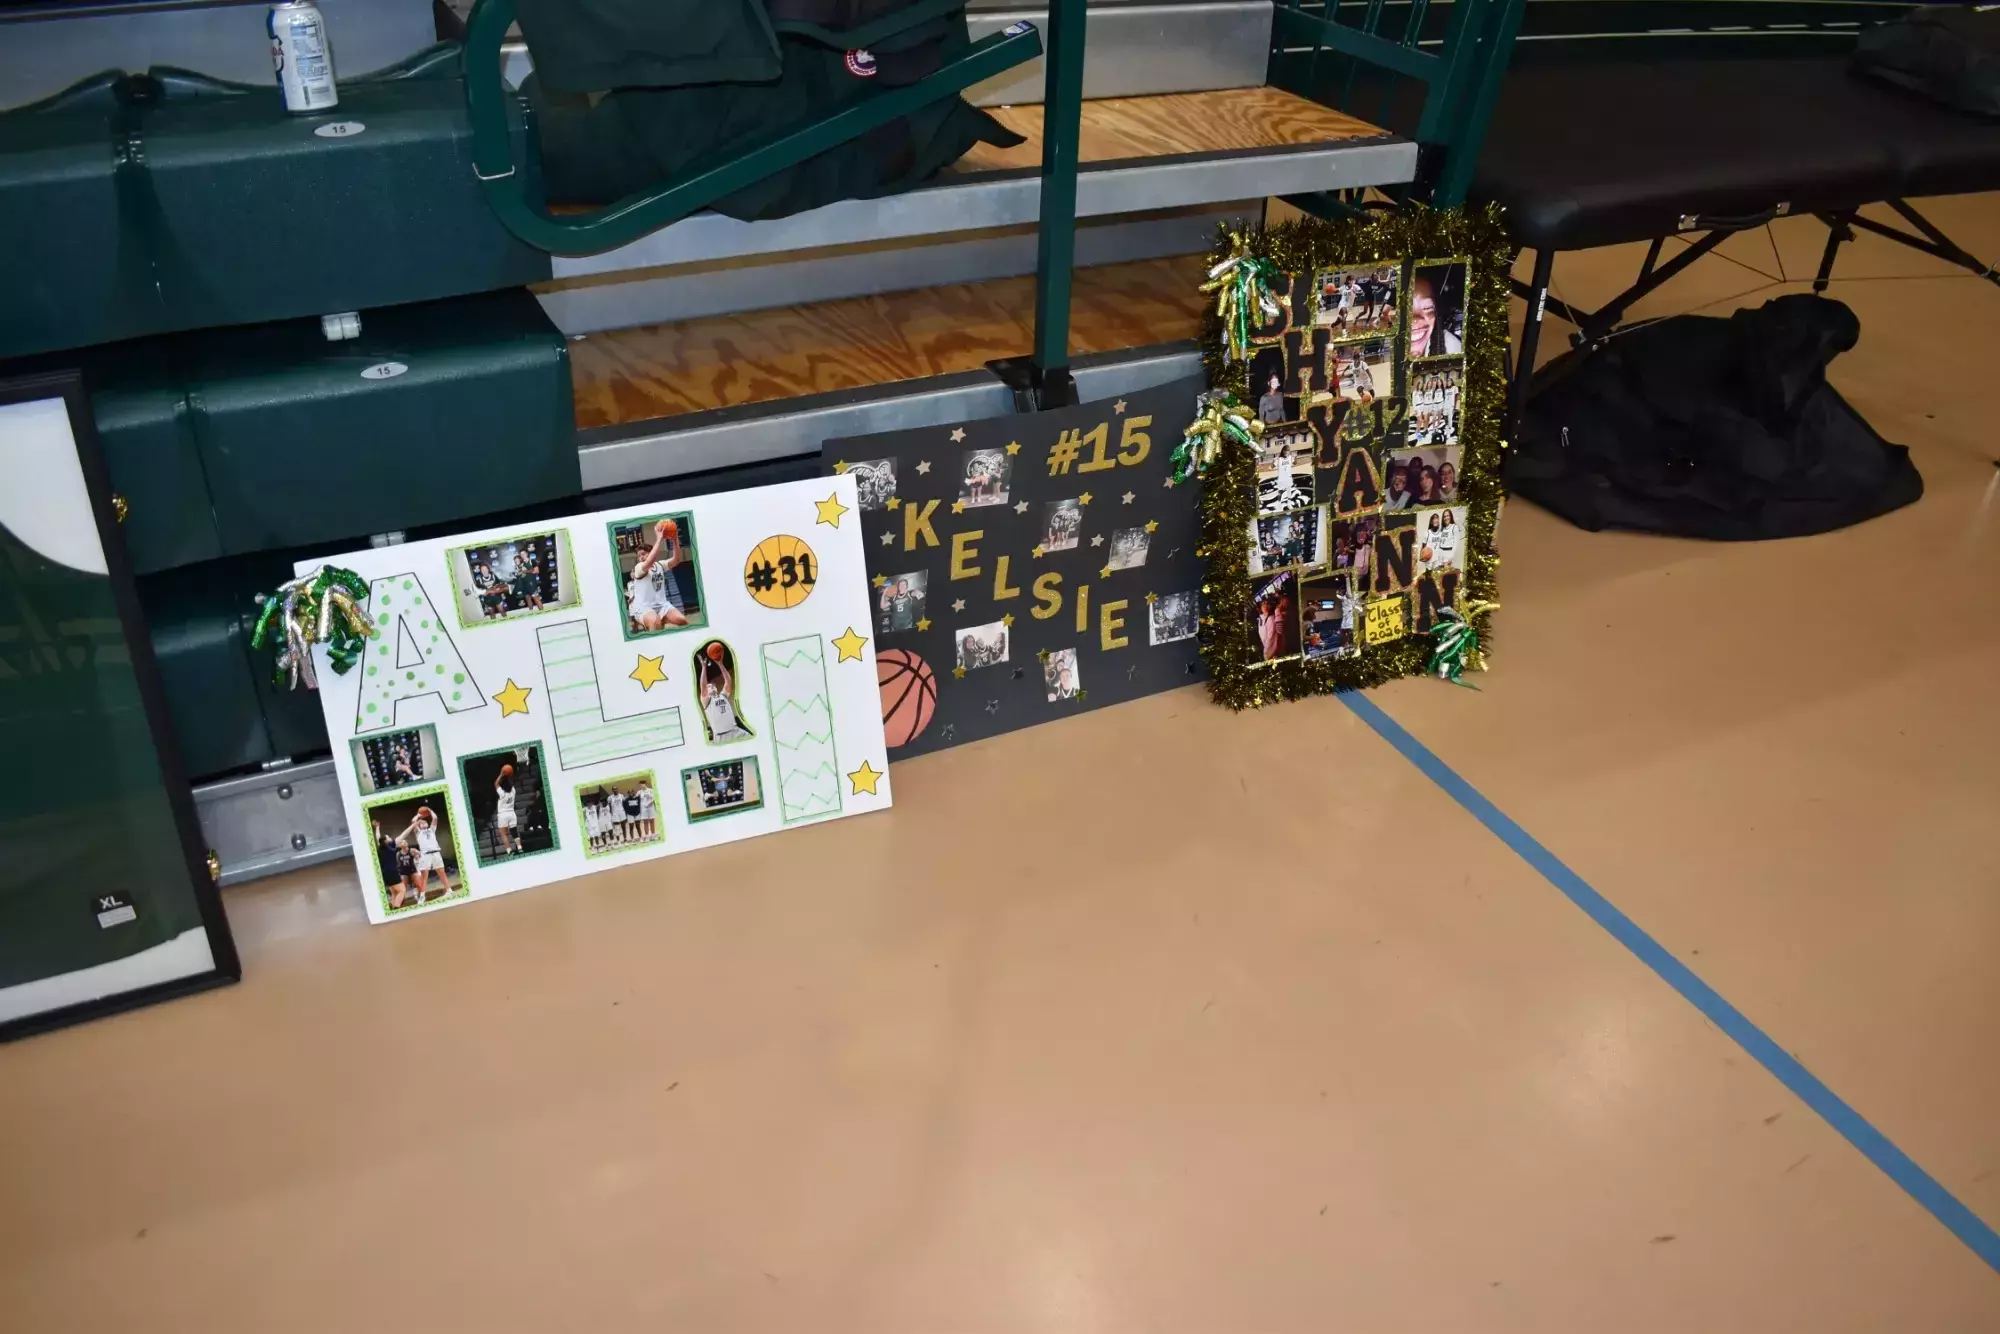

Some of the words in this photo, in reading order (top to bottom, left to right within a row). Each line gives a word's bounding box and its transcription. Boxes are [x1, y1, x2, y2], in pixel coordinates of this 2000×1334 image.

[332, 125, 346, 134] 15
[377, 366, 391, 375] 15
[1046, 415, 1152, 477] #15
[746, 552, 816, 593] #31
[904, 499, 1129, 651] KELSIE
[1367, 603, 1401, 622] Class
[1378, 617, 1391, 630] of
[1369, 624, 1402, 642] 2026
[99, 895, 124, 910] XL
